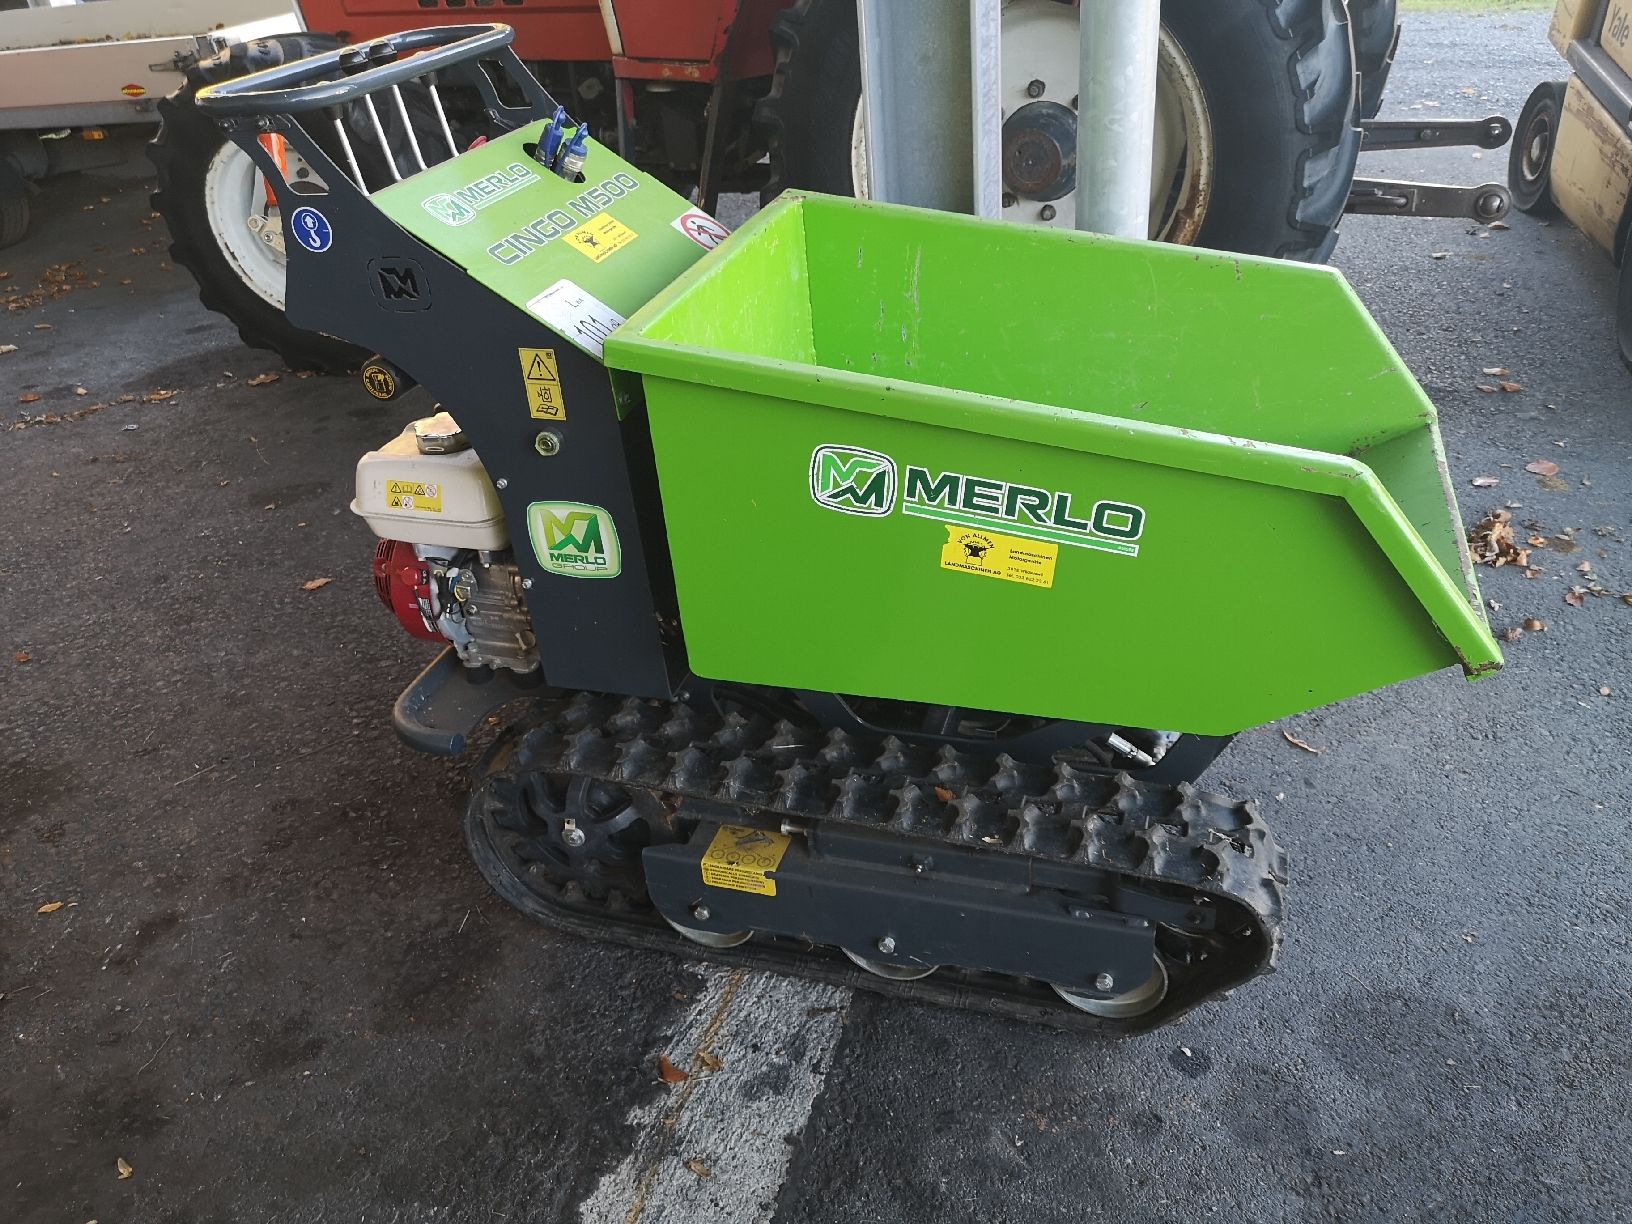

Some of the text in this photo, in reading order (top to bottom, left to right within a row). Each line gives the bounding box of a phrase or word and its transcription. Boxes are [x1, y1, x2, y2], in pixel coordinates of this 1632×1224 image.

[1608, 3, 1630, 48] Yale
[455, 162, 534, 205] MERLO
[487, 172, 641, 265] CINGO M500
[904, 465, 1145, 540] MERLO
[549, 552, 607, 566] MERLO
[551, 562, 608, 571] GROUP
